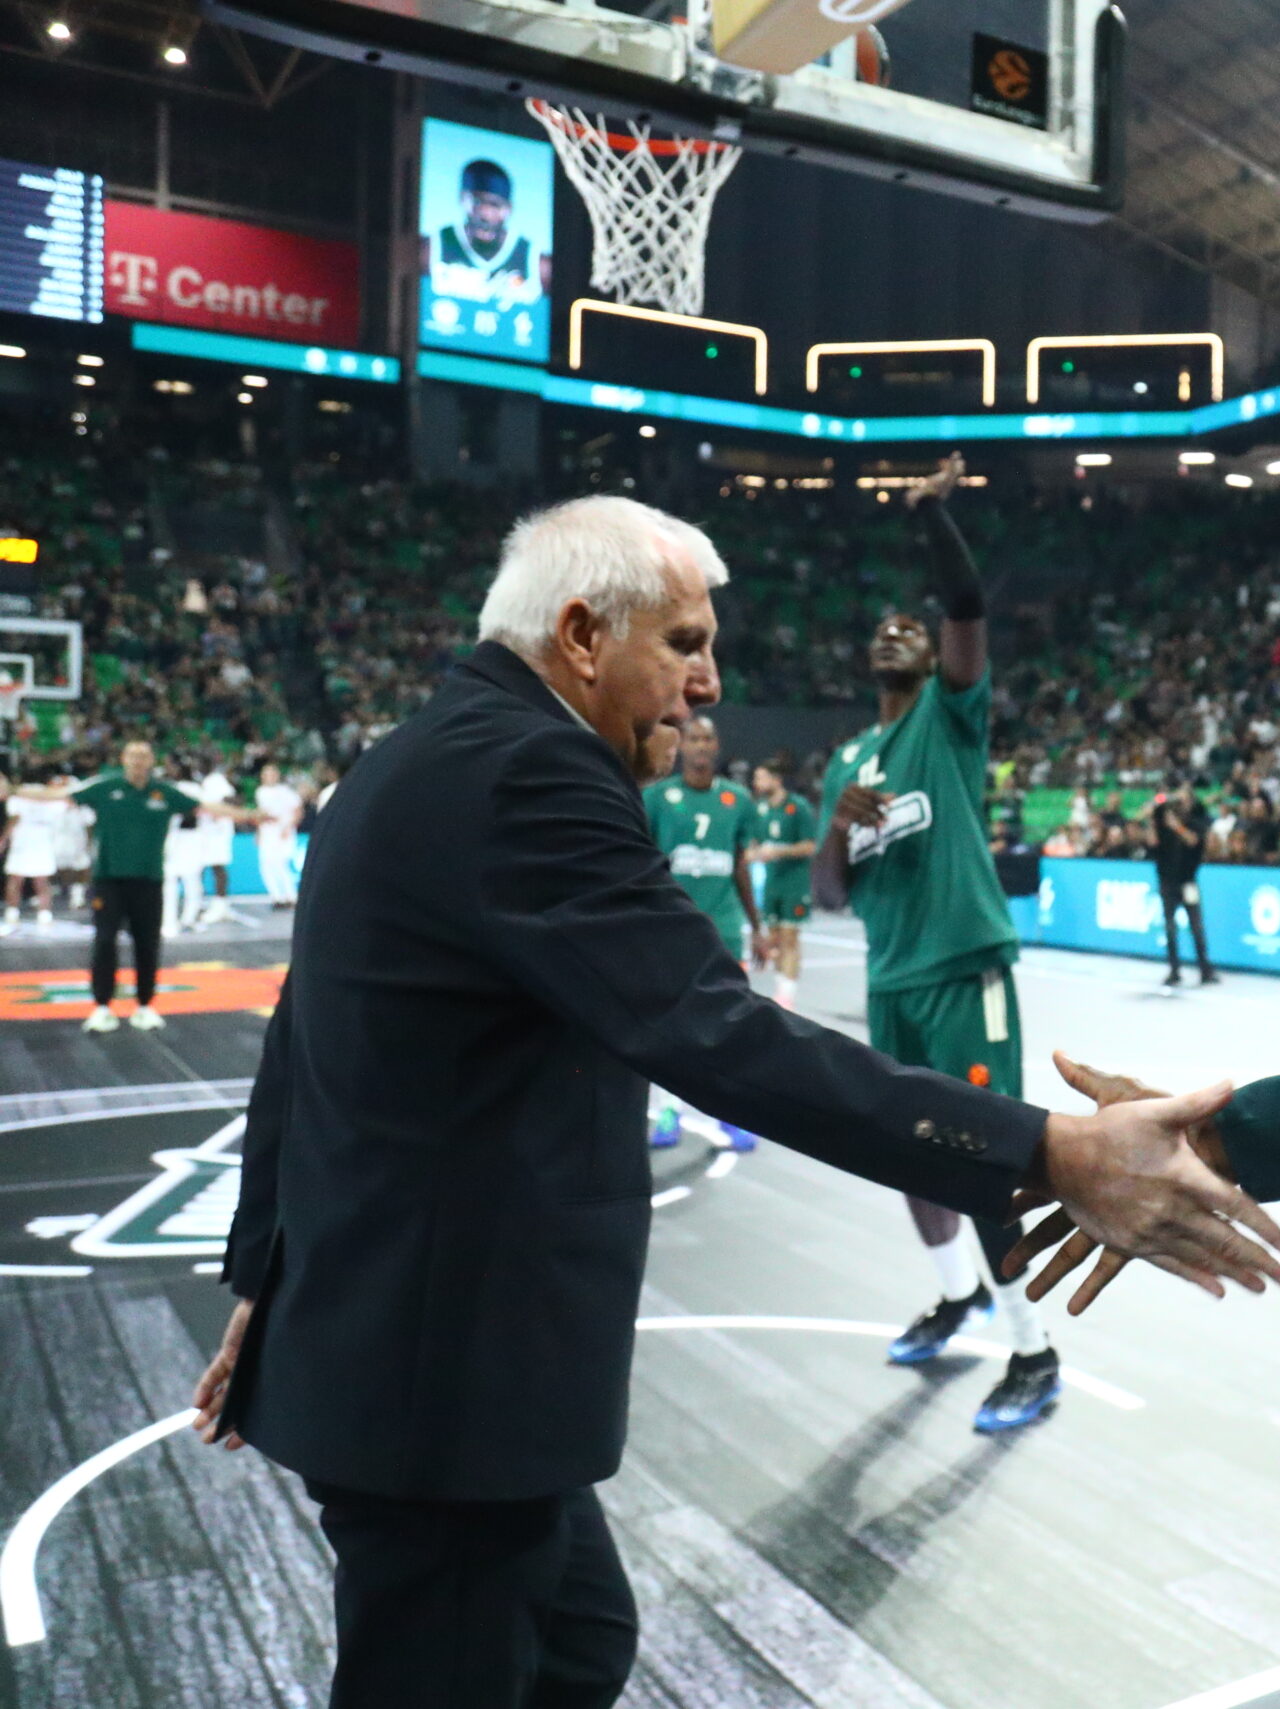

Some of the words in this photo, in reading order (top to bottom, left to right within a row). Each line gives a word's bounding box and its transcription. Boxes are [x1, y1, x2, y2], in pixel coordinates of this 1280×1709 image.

[110, 251, 157, 306] T
[167, 266, 330, 325] Center
[694, 813, 711, 840] 7
